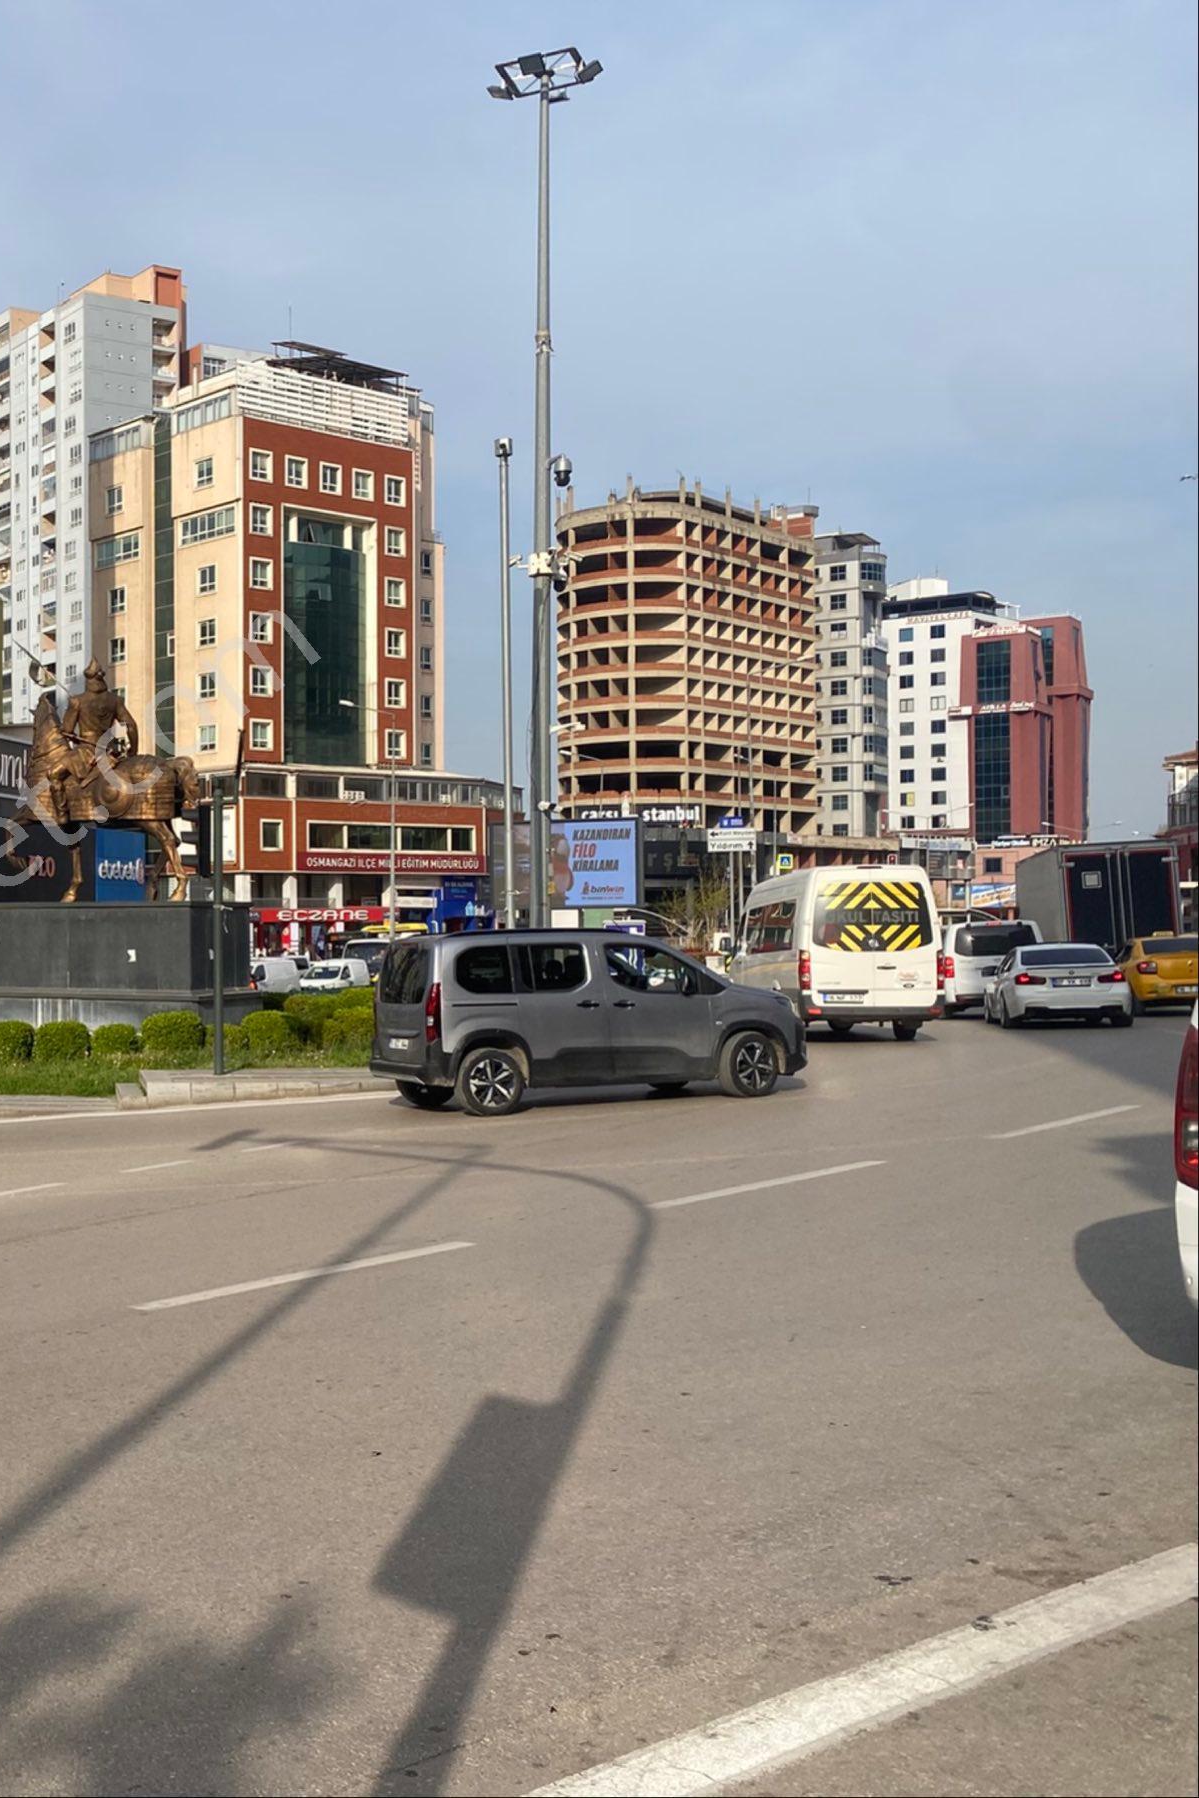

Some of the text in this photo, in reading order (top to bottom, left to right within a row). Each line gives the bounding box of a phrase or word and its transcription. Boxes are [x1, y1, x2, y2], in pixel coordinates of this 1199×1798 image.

[573, 828, 631, 841] KAZANDIRAN
[573, 842, 597, 858] FİLO
[306, 857, 356, 869] OSMANGAZİ
[357, 857, 377, 869] İLÇE
[402, 857, 429, 869] EĞİTİM
[430, 857, 479, 870] MÜDÜRLÜĞÜ
[572, 858, 619, 872] KİRALAMA
[276, 909, 369, 921] ECZANE
